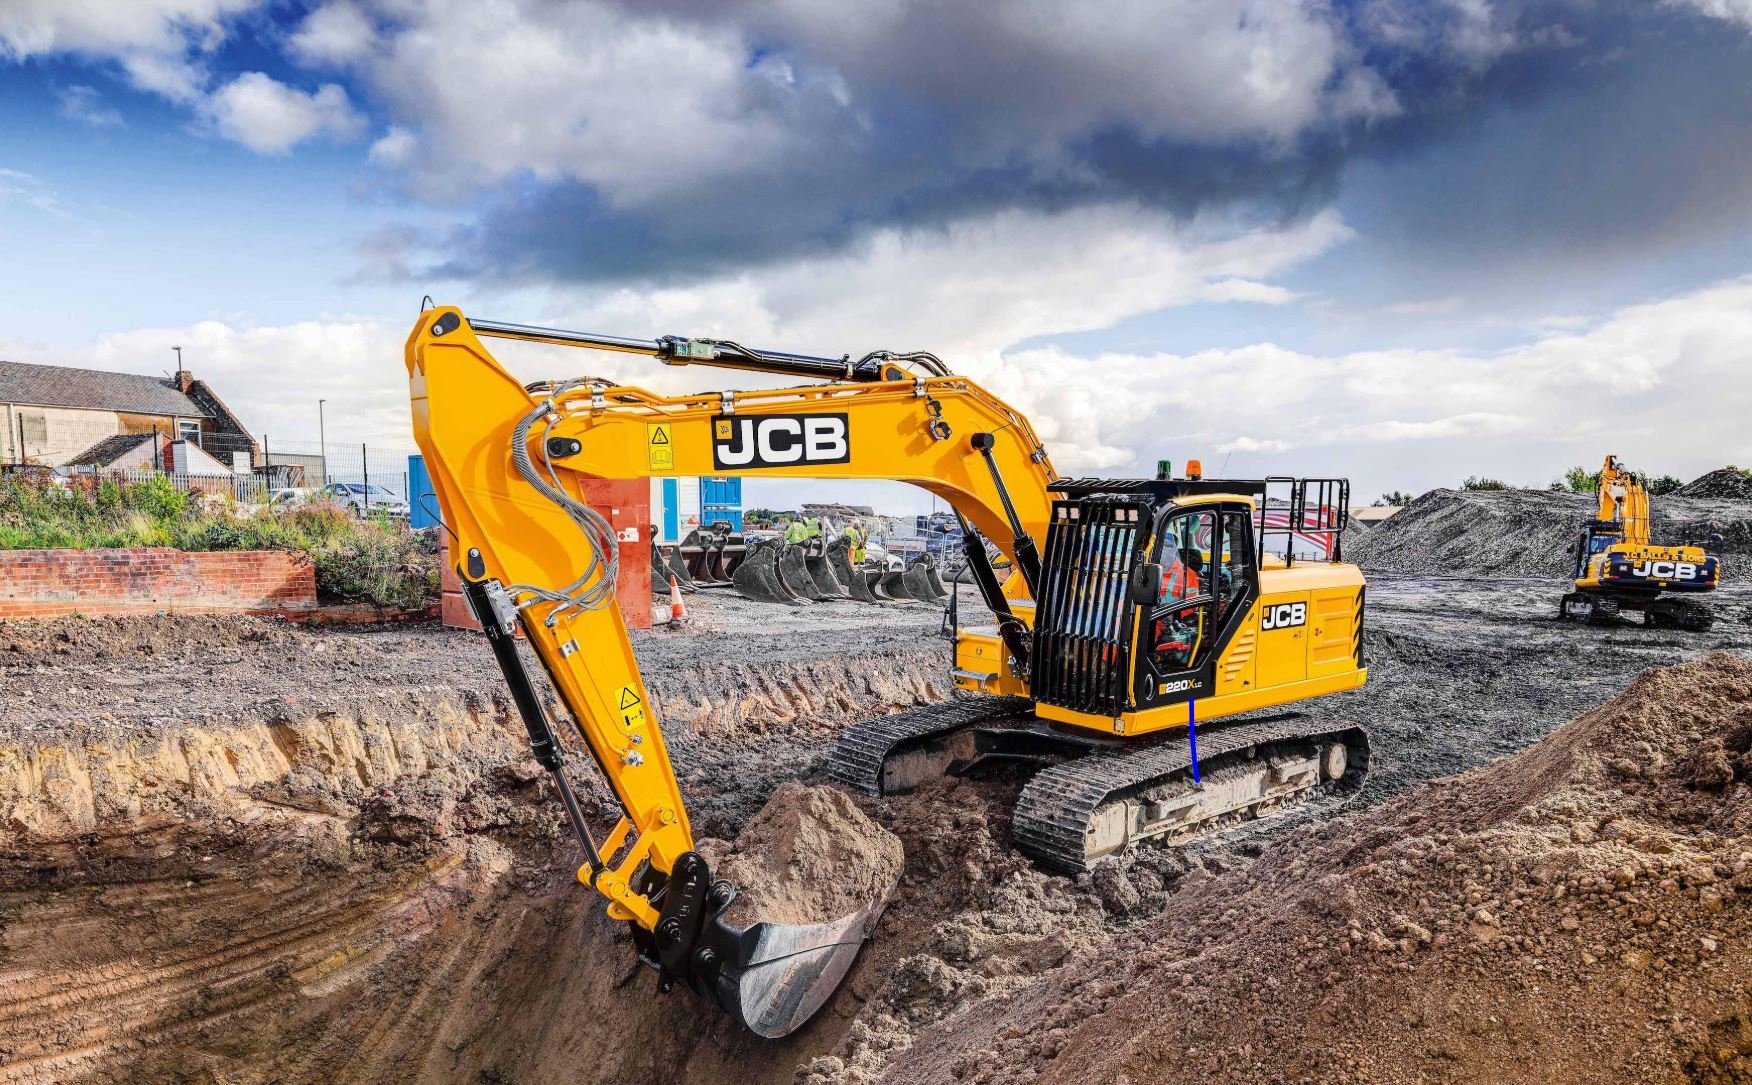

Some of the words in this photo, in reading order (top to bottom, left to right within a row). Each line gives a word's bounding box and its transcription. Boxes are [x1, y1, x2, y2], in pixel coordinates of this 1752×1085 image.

[717, 417, 847, 465] JCB
[1640, 552, 1669, 560] BALLS
[1672, 553, 1679, 561] &
[1682, 554, 1707, 563] SONS
[1633, 561, 1696, 579] JCB
[1263, 603, 1306, 629] JCB
